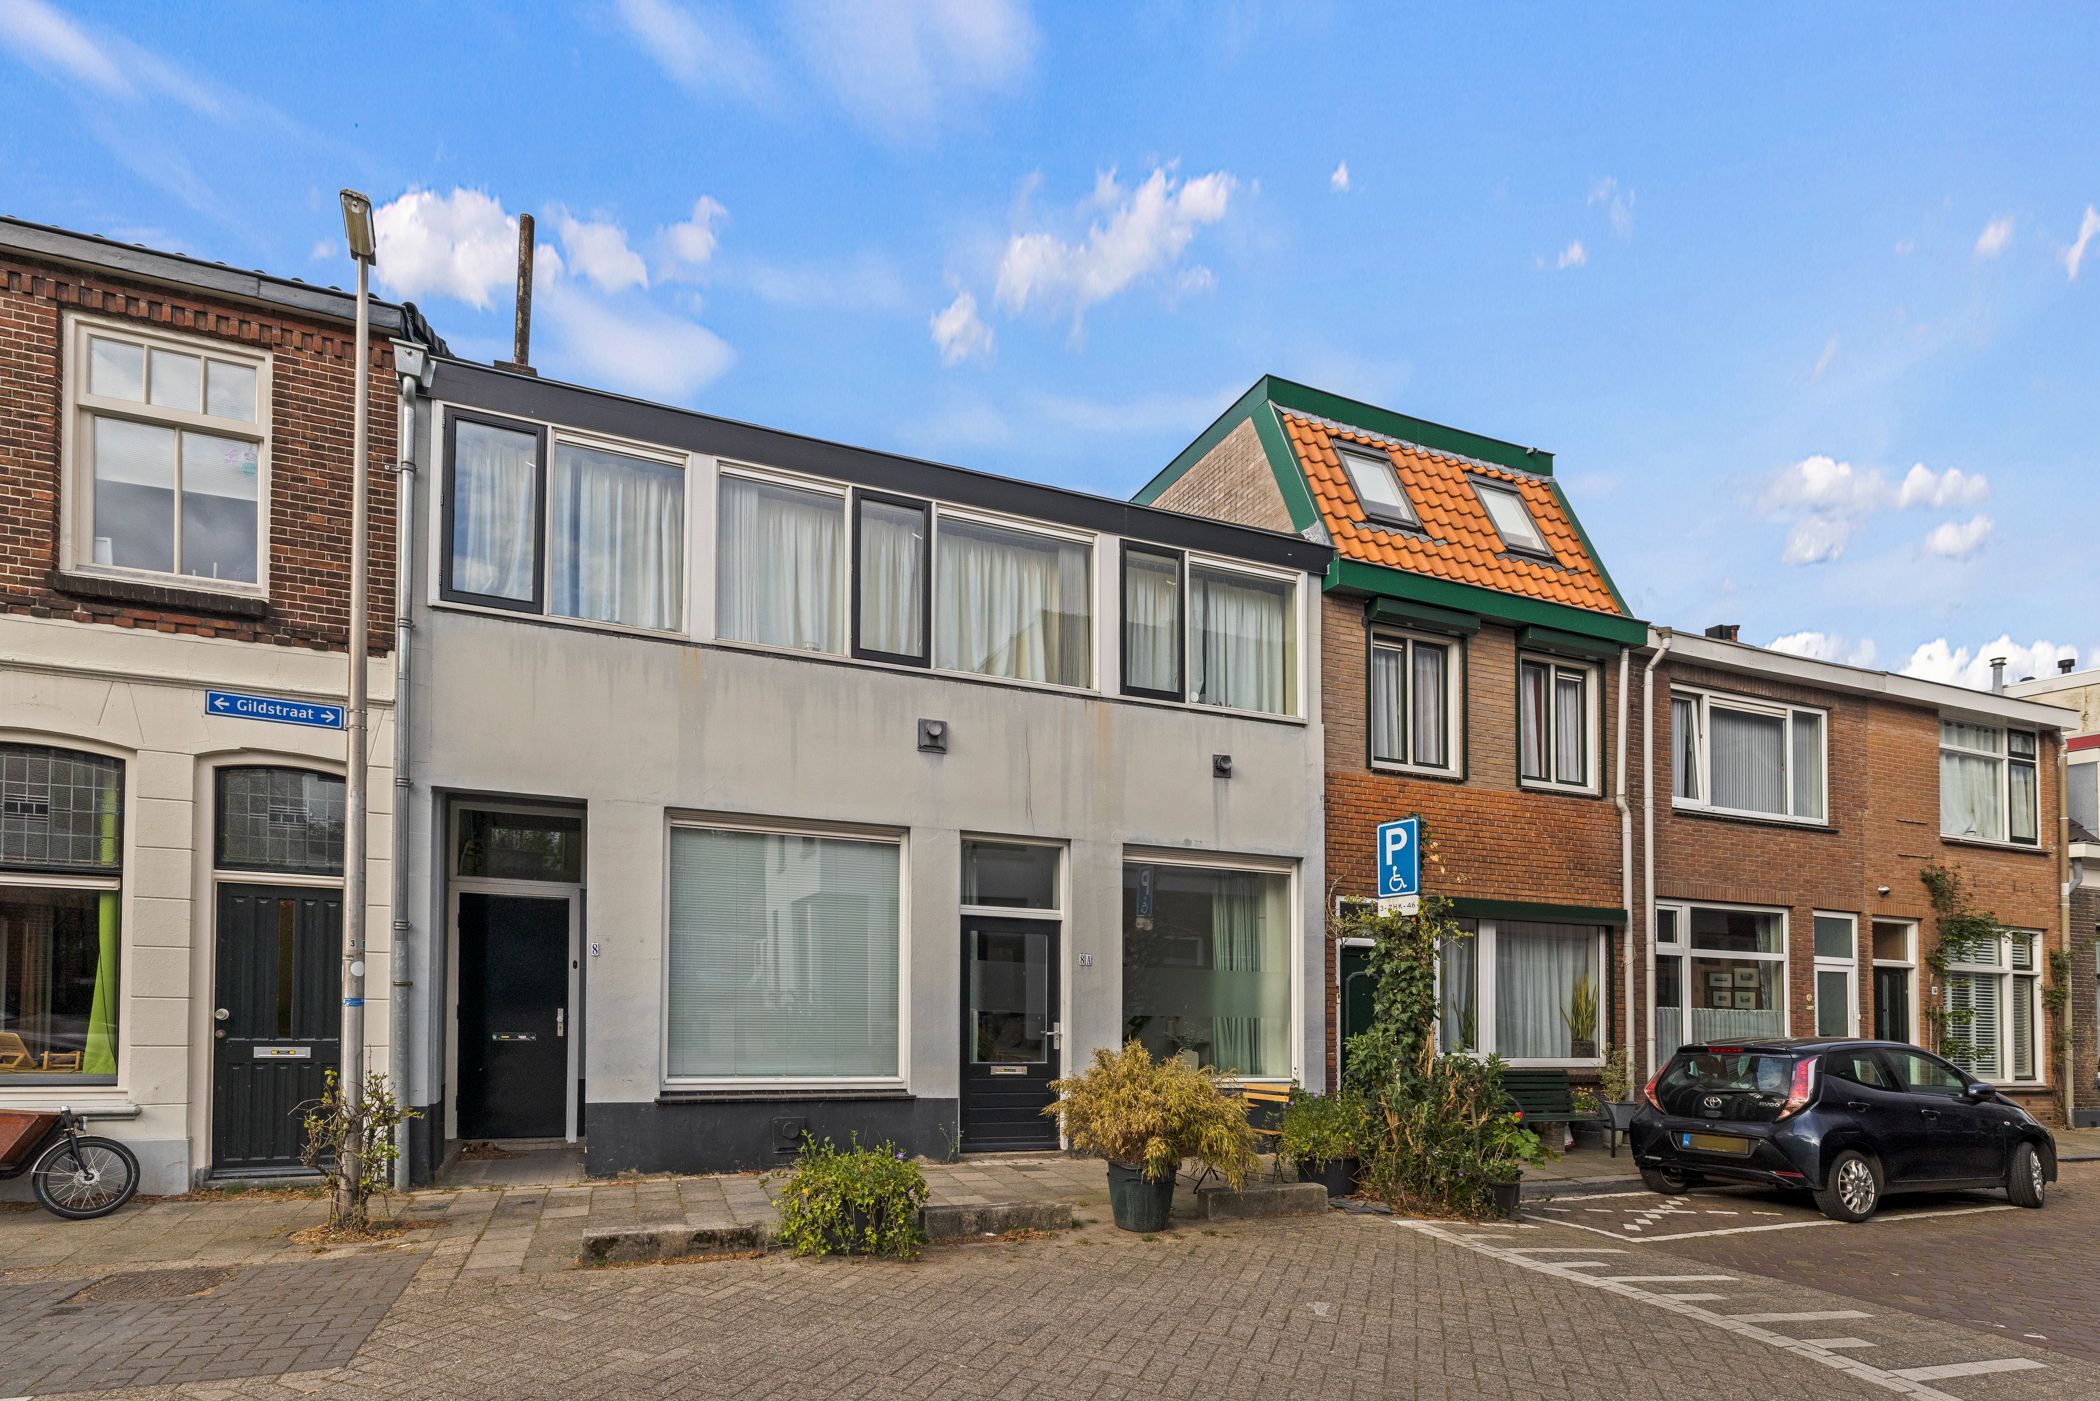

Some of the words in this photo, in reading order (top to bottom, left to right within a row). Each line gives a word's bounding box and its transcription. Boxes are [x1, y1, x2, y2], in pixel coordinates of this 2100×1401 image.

[236, 700, 314, 719] Gildstraat
[1385, 827, 1408, 866] P
[350, 939, 356, 947] 3
[592, 943, 598, 955] 8
